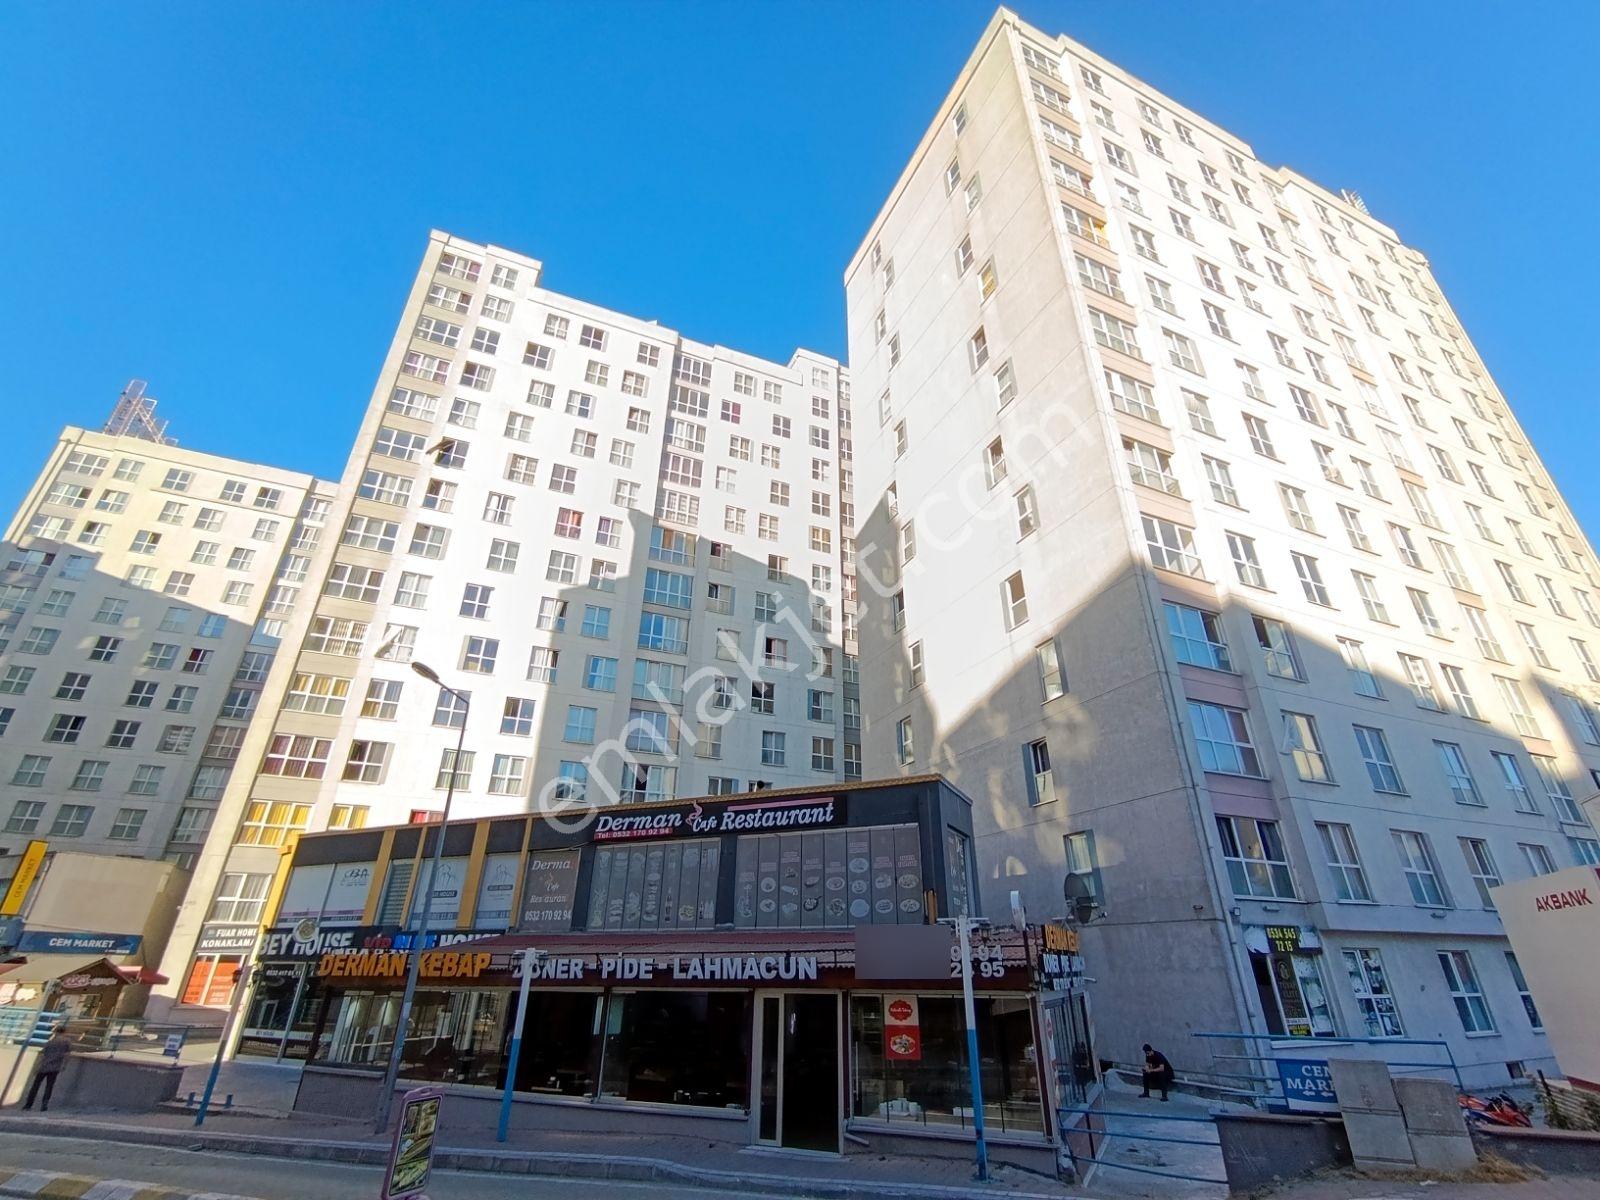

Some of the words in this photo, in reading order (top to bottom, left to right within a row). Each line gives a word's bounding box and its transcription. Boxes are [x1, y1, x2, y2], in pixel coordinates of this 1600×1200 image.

[596, 811, 682, 832] Derman
[692, 815, 718, 832] Cafe
[719, 803, 834, 830] Restaurant
[1536, 888, 1593, 912] AKBANK
[525, 911, 540, 921] 0532
[541, 911, 553, 920] 170
[553, 911, 563, 920] 92
[563, 911, 572, 920] 94
[49, 938, 71, 947] CEM
[74, 939, 115, 948] MARKET
[216, 929, 236, 938] FUAR
[259, 933, 292, 955] BEY
[978, 945, 1003, 961] 94
[319, 953, 407, 976] DERMAN
[419, 953, 492, 977] KEBAP
[673, 956, 817, 980] LAHMACUN
[980, 962, 1004, 977] 95
